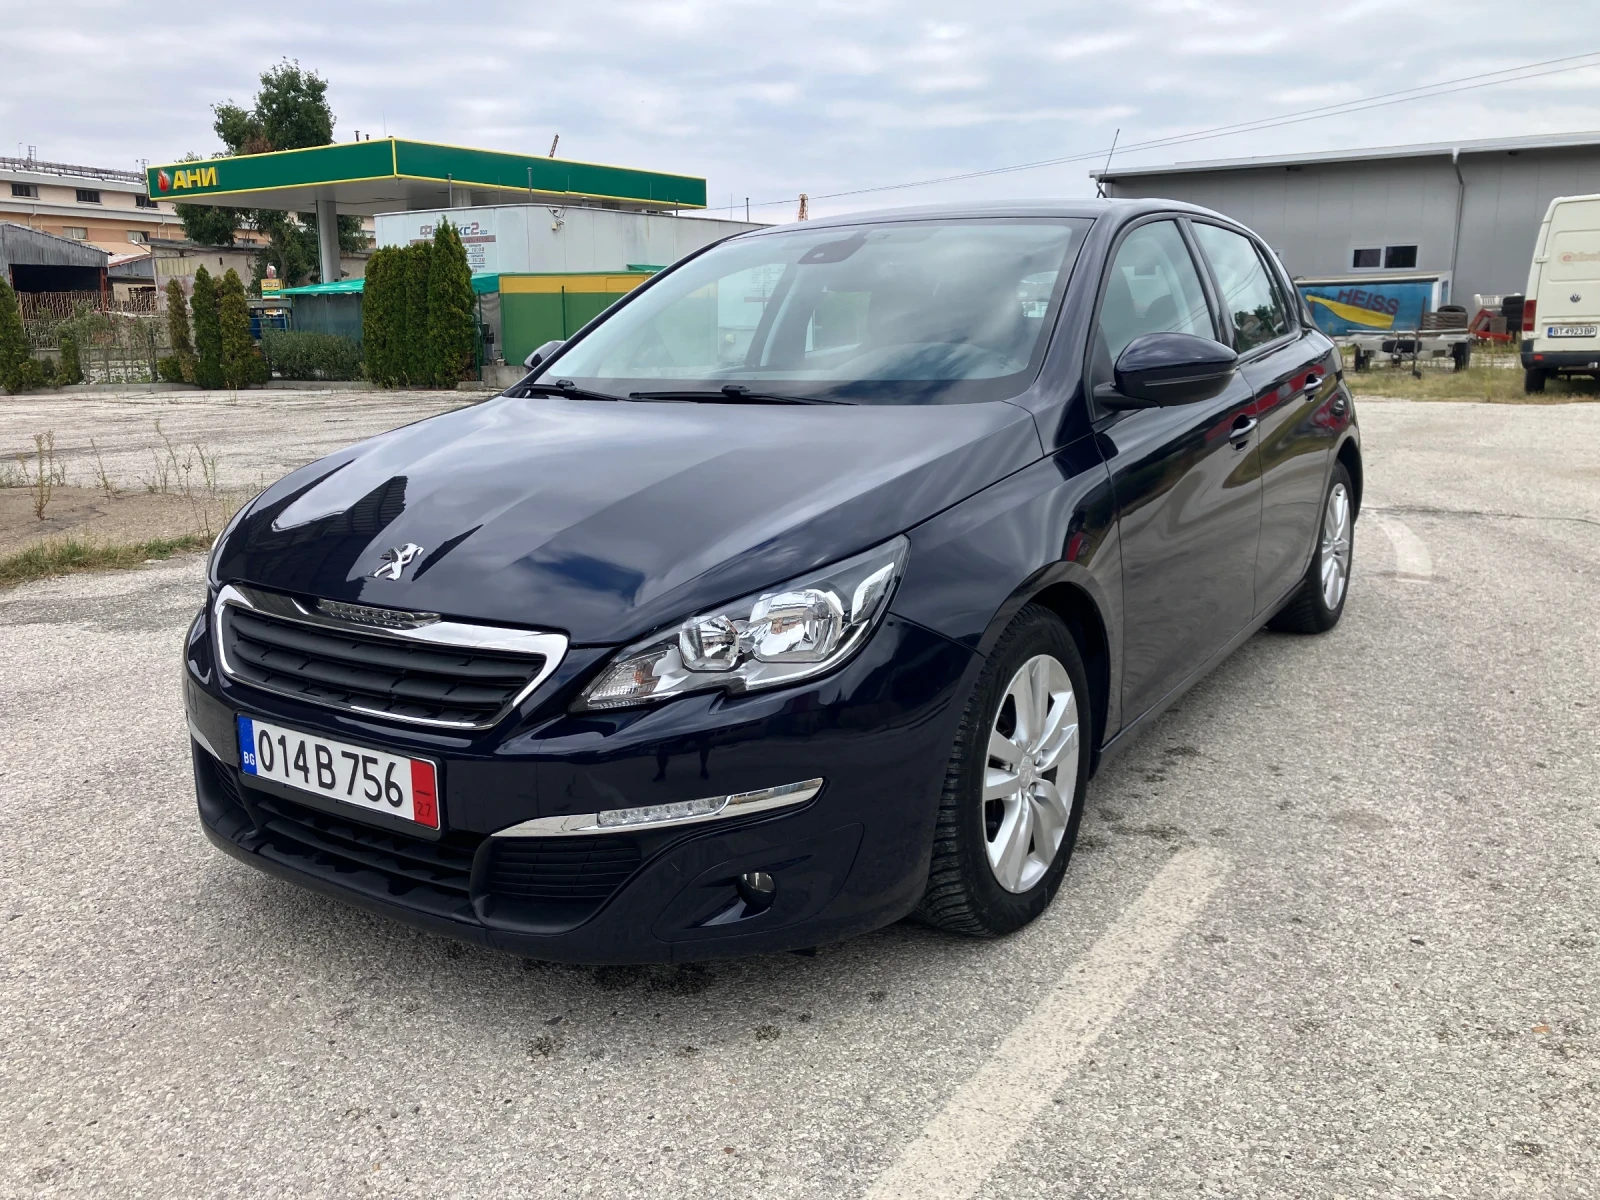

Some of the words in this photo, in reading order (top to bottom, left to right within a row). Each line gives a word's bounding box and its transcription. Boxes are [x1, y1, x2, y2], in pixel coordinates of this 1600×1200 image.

[173, 166, 217, 190] АНИ
[1337, 289, 1400, 315] HEISS
[243, 751, 256, 766] BG
[417, 801, 432, 818] 27
